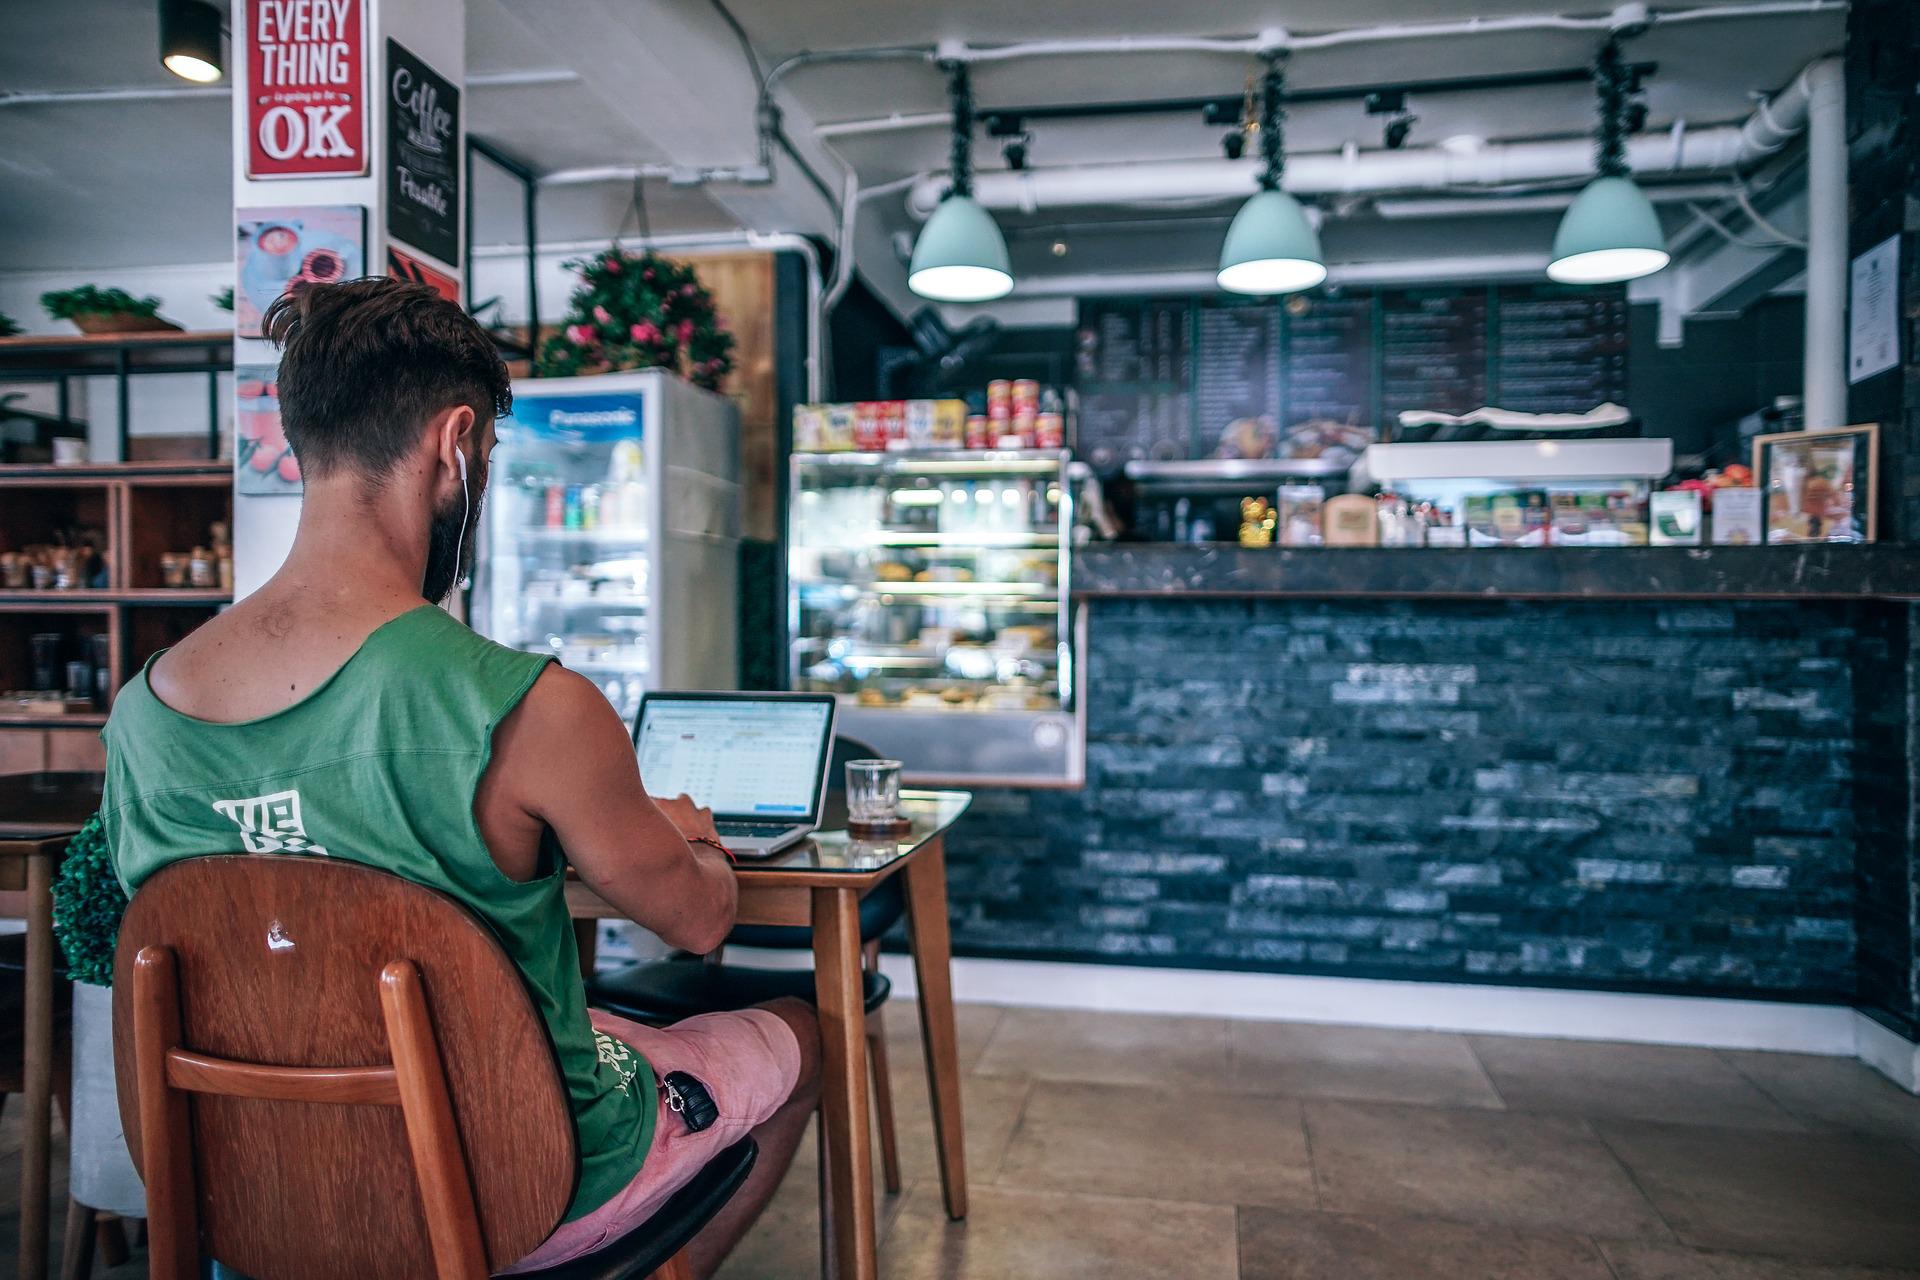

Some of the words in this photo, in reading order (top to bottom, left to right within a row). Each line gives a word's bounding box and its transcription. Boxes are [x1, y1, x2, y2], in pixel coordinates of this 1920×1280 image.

[258, 0, 350, 42] EVERY
[260, 42, 350, 86] THING
[259, 105, 355, 160] OK
